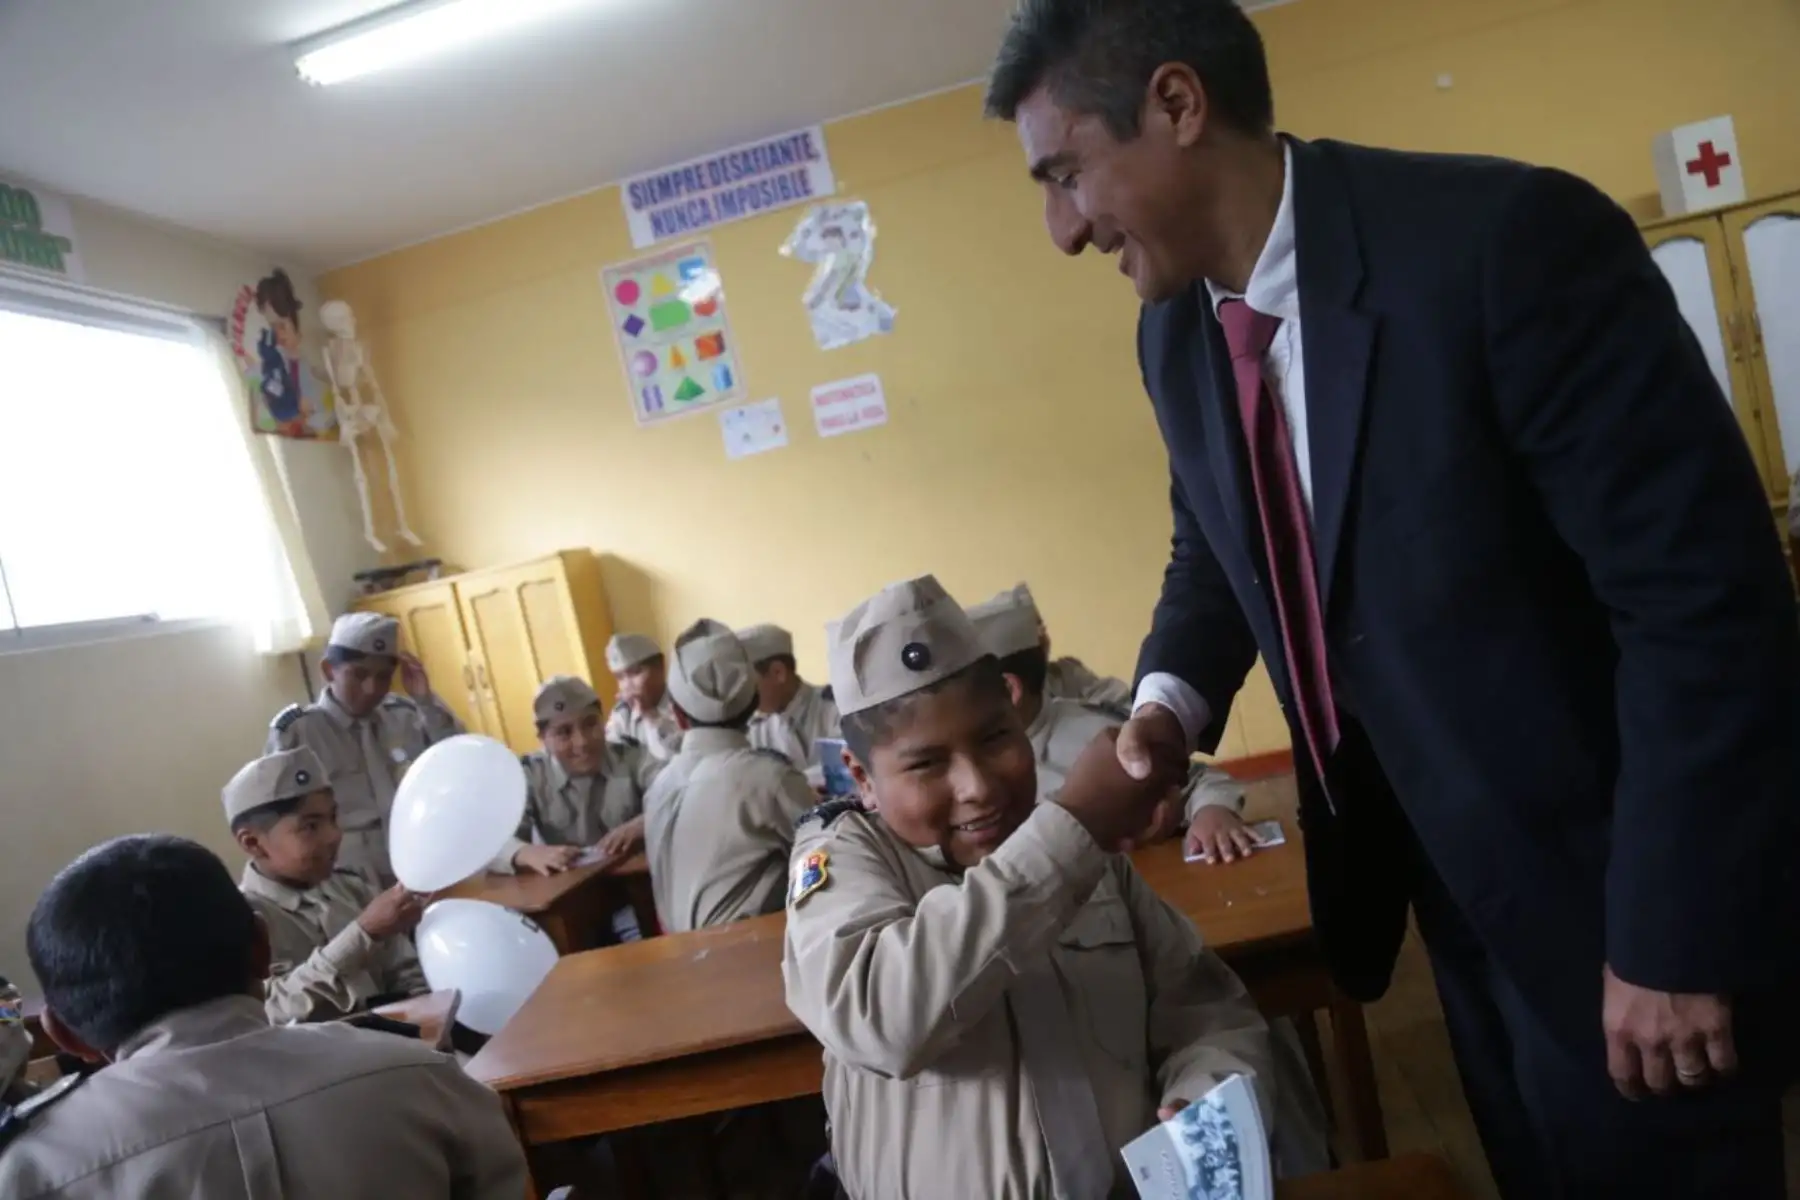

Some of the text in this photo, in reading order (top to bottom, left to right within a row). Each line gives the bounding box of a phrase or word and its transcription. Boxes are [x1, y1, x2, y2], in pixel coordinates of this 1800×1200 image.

[629, 132, 820, 212] SIEMPRE DESAFIANTE,
[650, 168, 812, 238] NUNCA IMPOSIBLE
